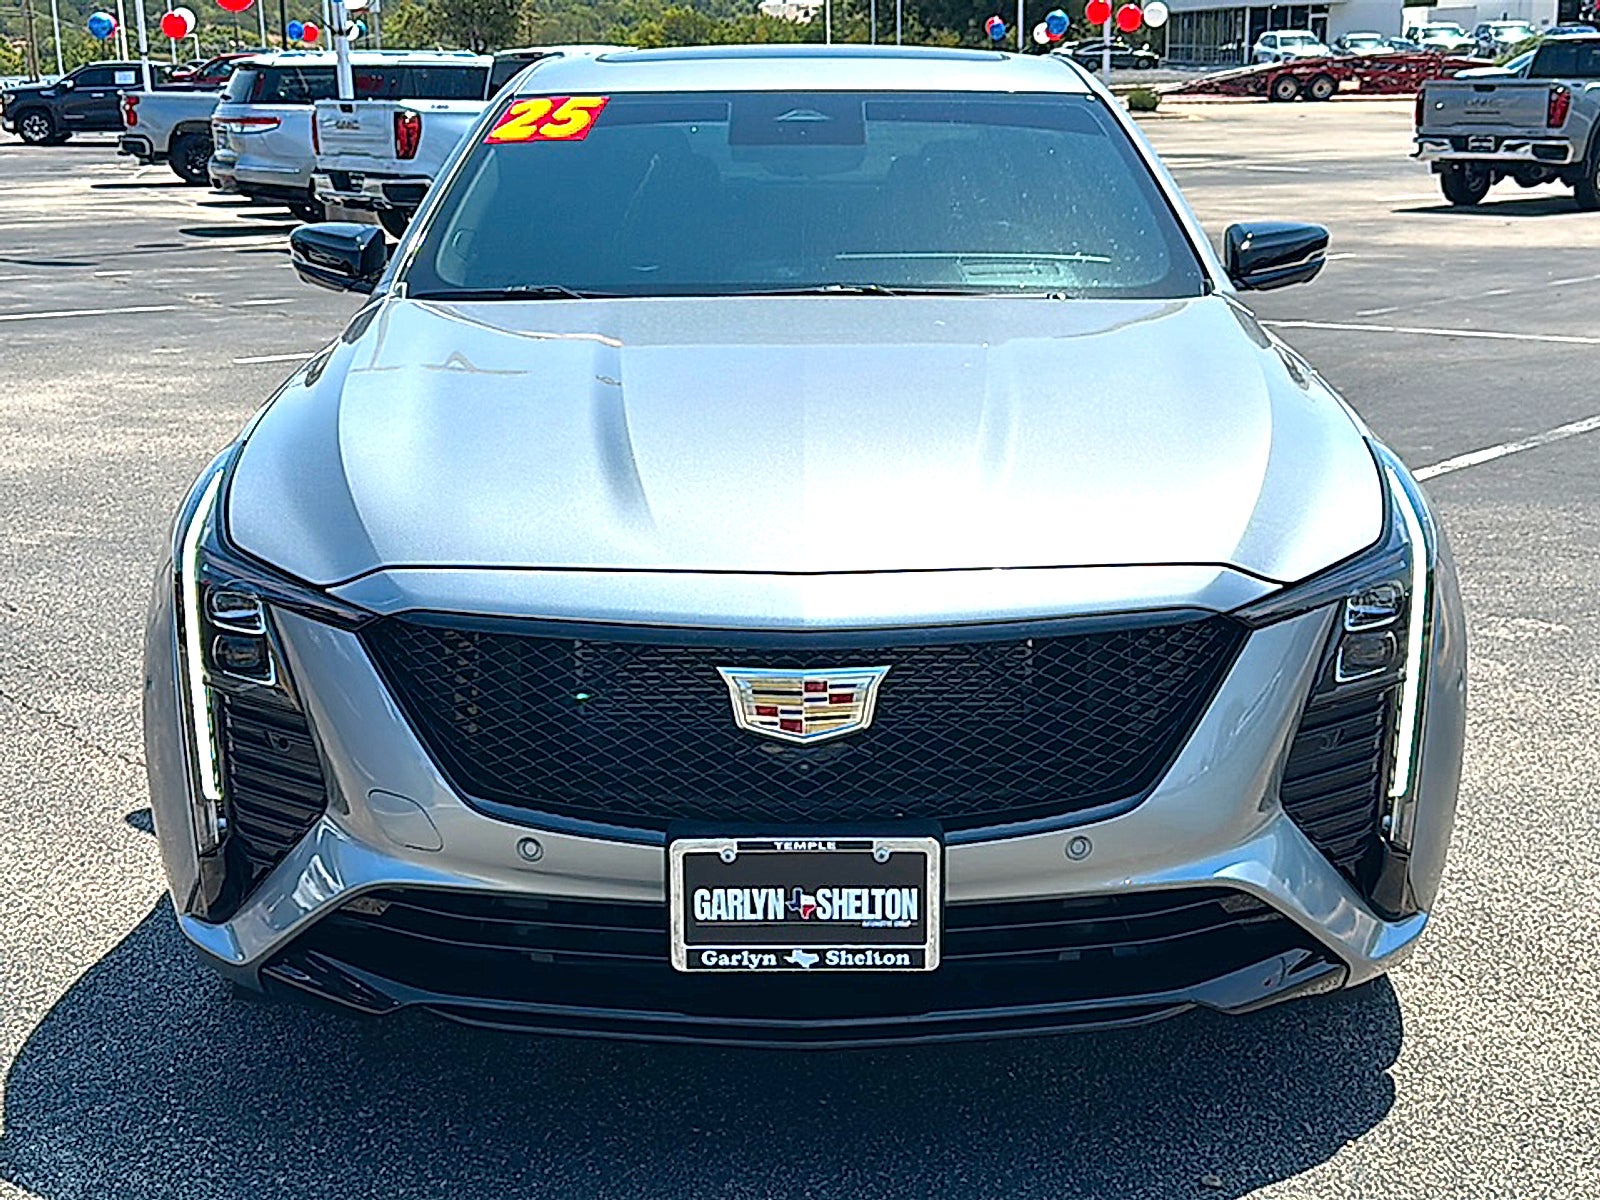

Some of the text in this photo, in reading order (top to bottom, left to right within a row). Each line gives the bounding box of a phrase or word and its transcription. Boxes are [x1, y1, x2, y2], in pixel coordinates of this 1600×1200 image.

[490, 96, 605, 140] 25
[773, 841, 837, 850] TEMPLE
[693, 888, 918, 921] GARLYN SHELTON
[701, 950, 911, 969] Garlyn Shelton
